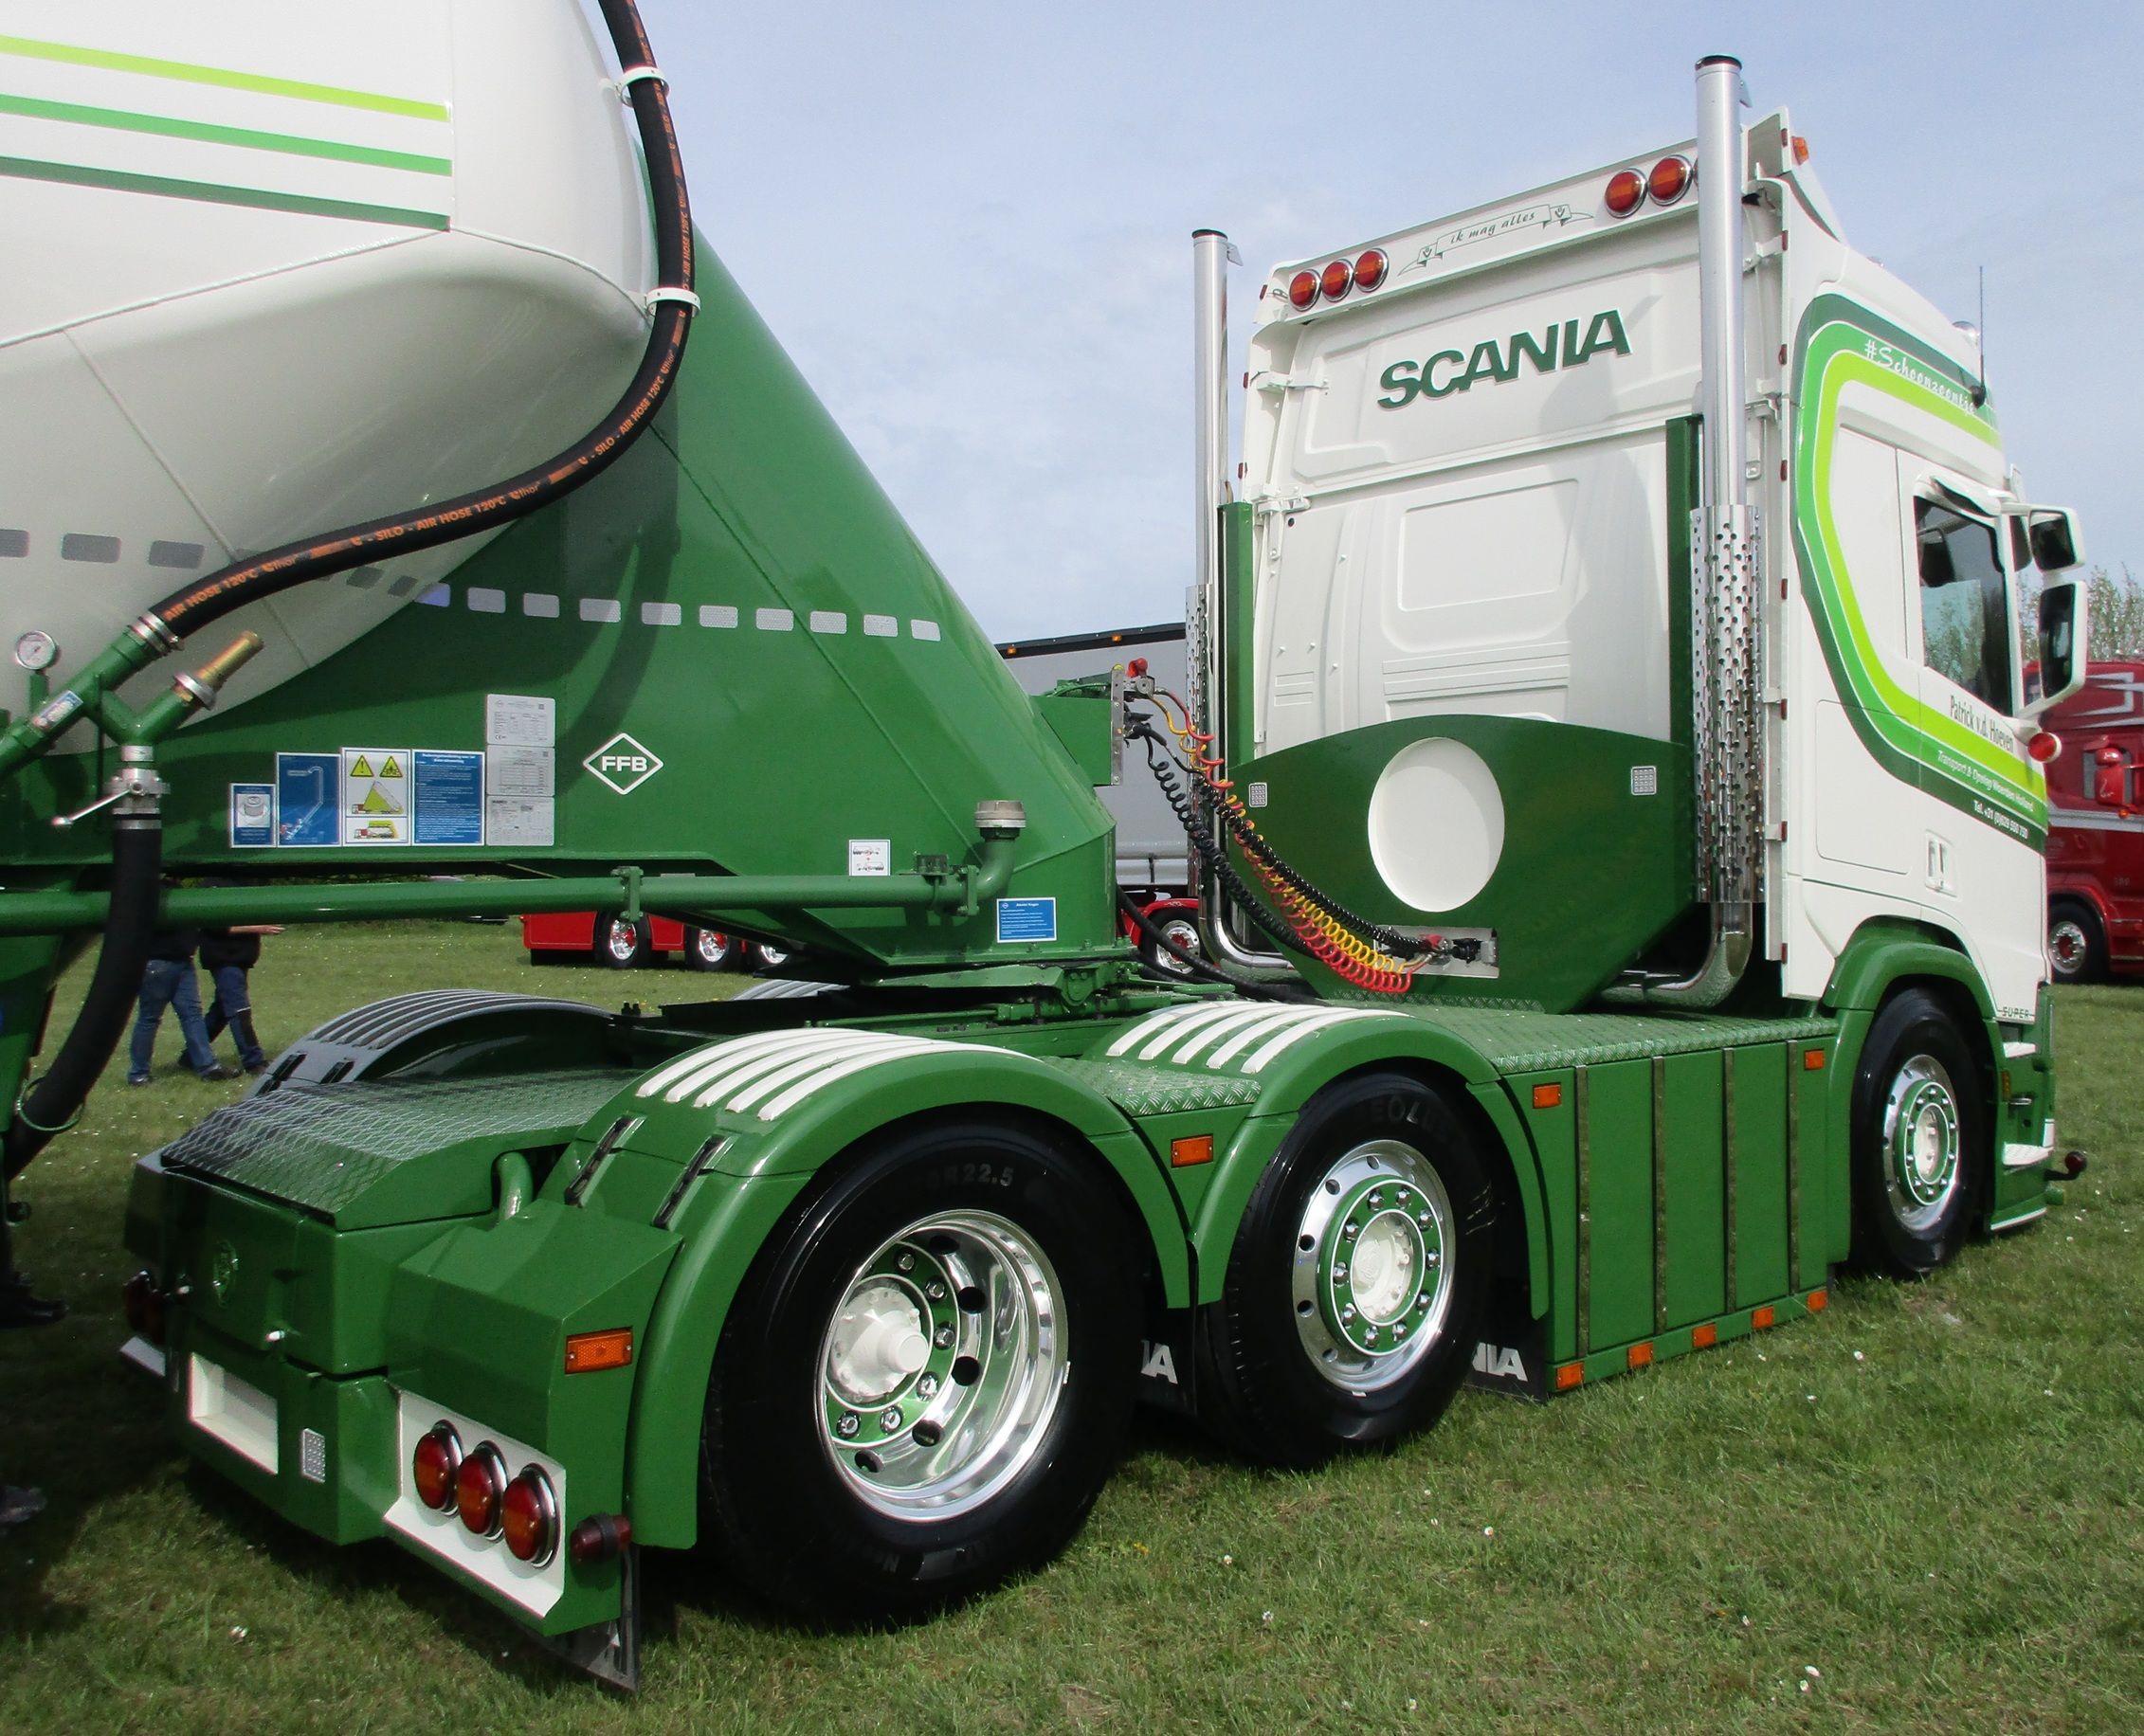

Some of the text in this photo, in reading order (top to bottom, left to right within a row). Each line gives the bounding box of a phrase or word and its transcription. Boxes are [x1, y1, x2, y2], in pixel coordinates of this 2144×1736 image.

[1468, 224, 1496, 241] mag
[1501, 210, 1535, 228] alles
[1377, 309, 1631, 409] SCANIA
[594, 436, 615, 456] SILO
[619, 416, 634, 436] AIR
[630, 398, 651, 422] HOSE
[375, 524, 405, 541] SILO
[414, 517, 438, 532] AIR
[440, 507, 473, 524] HOSE
[162, 601, 188, 622] AIR
[186, 583, 223, 607] HOSE
[1951, 696, 1973, 730] Patrick
[602, 755, 647, 772] FFB
[2002, 1006, 2029, 1020] SUPER
